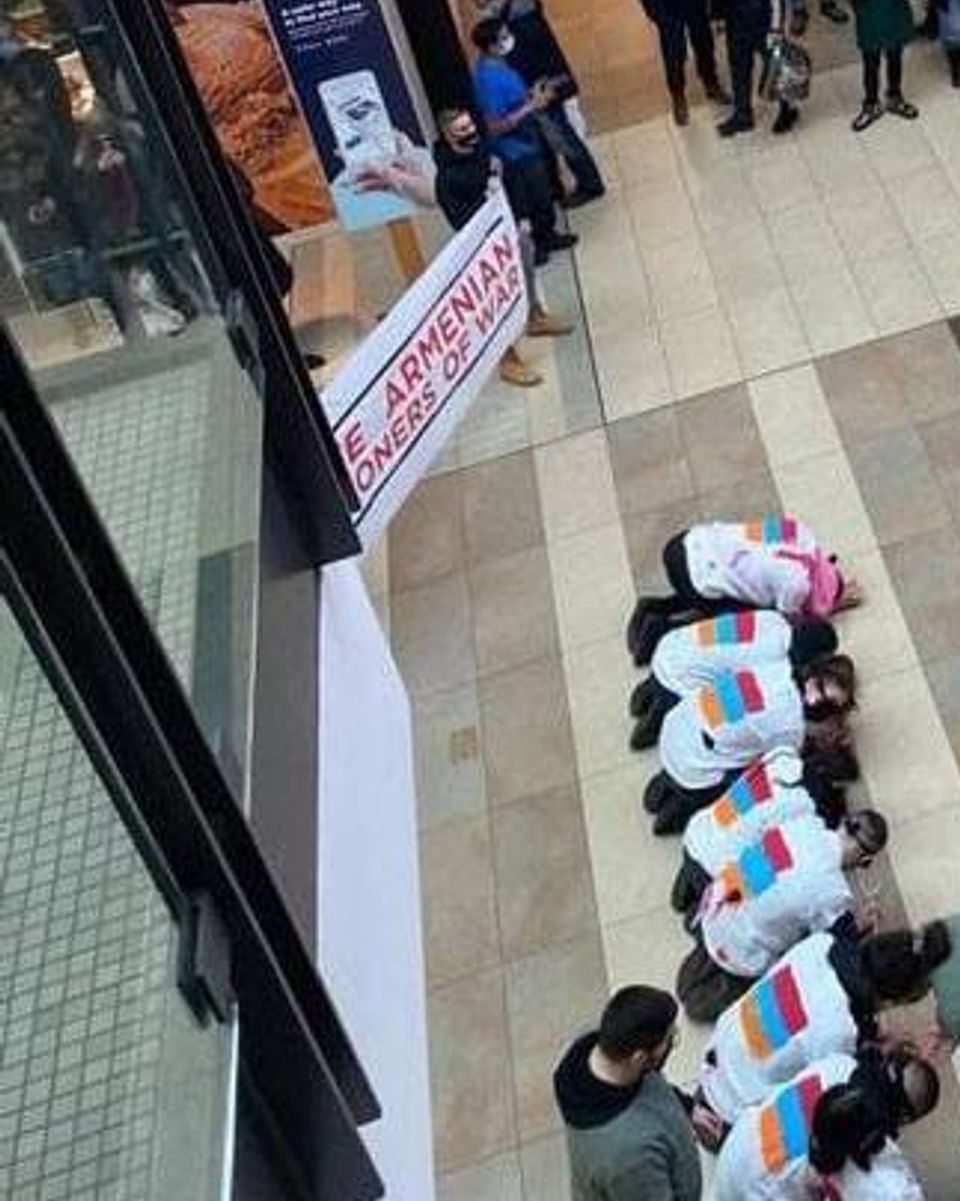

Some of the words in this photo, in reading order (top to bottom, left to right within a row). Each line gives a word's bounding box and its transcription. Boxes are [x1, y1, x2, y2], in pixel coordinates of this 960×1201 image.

[355, 381, 437, 493] ONERS
[442, 336, 472, 381] OF
[476, 264, 521, 336] WAR
[385, 233, 514, 418] ARMENIAN
